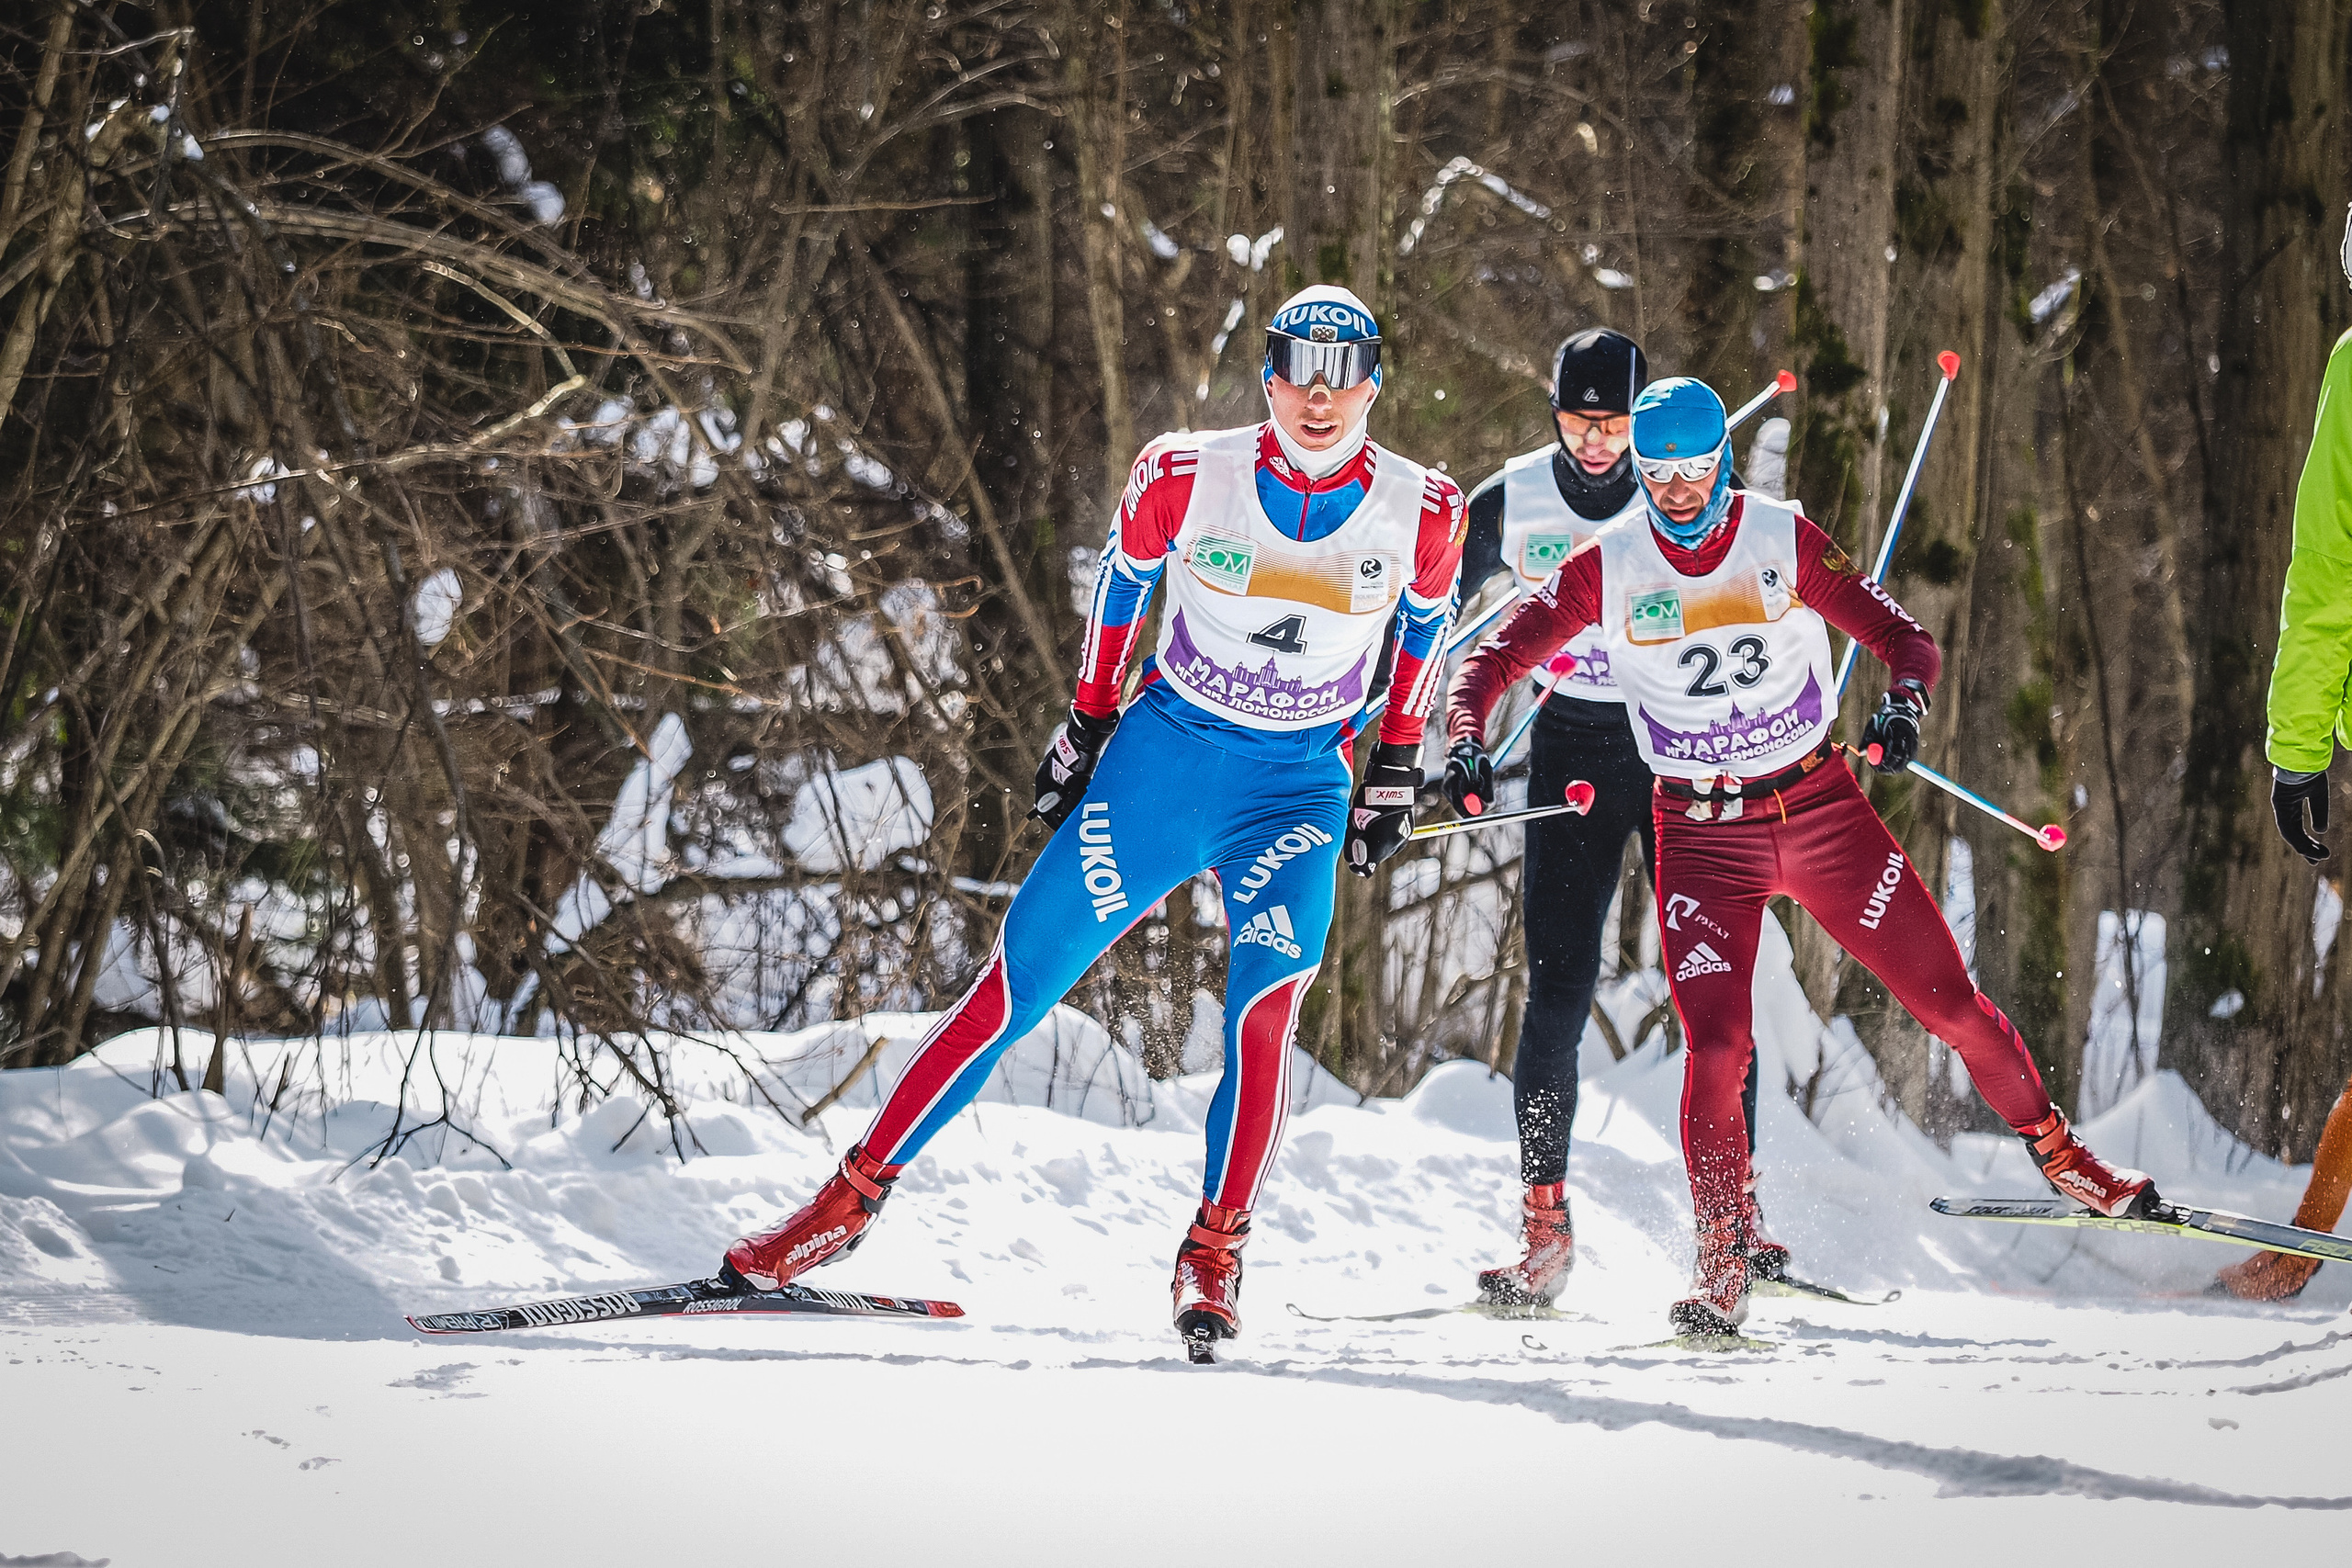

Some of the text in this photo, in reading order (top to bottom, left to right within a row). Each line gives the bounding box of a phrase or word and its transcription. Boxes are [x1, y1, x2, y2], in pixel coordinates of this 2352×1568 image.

[1279, 305, 1370, 338] LUKOIL
[1247, 614, 1307, 654] 4
[1190, 655, 1339, 709] МАРАФОН
[1678, 634, 1772, 696] 23
[1174, 661, 1201, 686] МГУ
[1228, 695, 1346, 721] ЛОМОНОСОВА
[1079, 802, 1129, 922] LUKOIL
[1232, 822, 1333, 905] LUKOIL
[1859, 852, 1905, 930] LUKOIL
[1234, 927, 1302, 959] adidas
[1676, 961, 1732, 982] adidas
[2060, 1170, 2107, 1199] alpina
[785, 1224, 847, 1266] alpina
[2077, 1219, 2182, 1237] FISCHER
[2298, 1238, 2352, 1259] FISC
[518, 1292, 641, 1327] ROSSIGNOL
[683, 1298, 743, 1314] ROSSIGNOL
